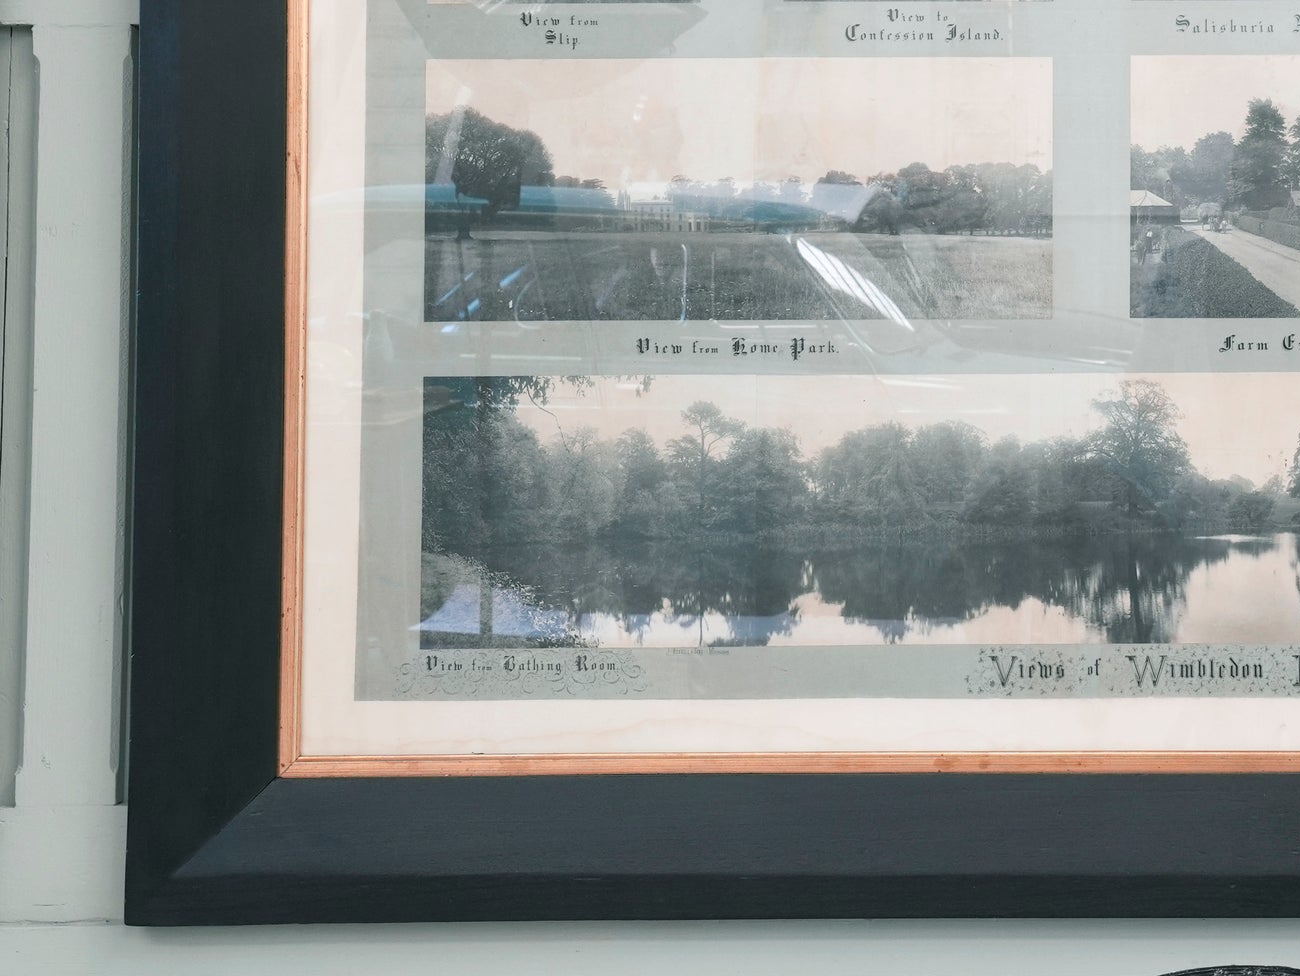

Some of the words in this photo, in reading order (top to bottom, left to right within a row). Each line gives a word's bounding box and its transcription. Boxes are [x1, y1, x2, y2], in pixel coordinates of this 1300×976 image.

[519, 11, 560, 27] View
[569, 14, 598, 26] from
[887, 8, 925, 23] View
[936, 10, 949, 22] to
[1175, 14, 1275, 34] Salisburia
[845, 24, 934, 42] Confession
[945, 24, 1004, 43] Island.
[636, 338, 683, 354] View
[692, 340, 719, 354] from
[731, 338, 778, 356] Home
[1219, 334, 1269, 353] Farm
[426, 655, 463, 672] View
[472, 658, 493, 672] from
[503, 655, 562, 676] Bathing
[989, 655, 1065, 688] Views
[1087, 657, 1101, 676] of
[1124, 655, 1263, 688] Wimbledon
